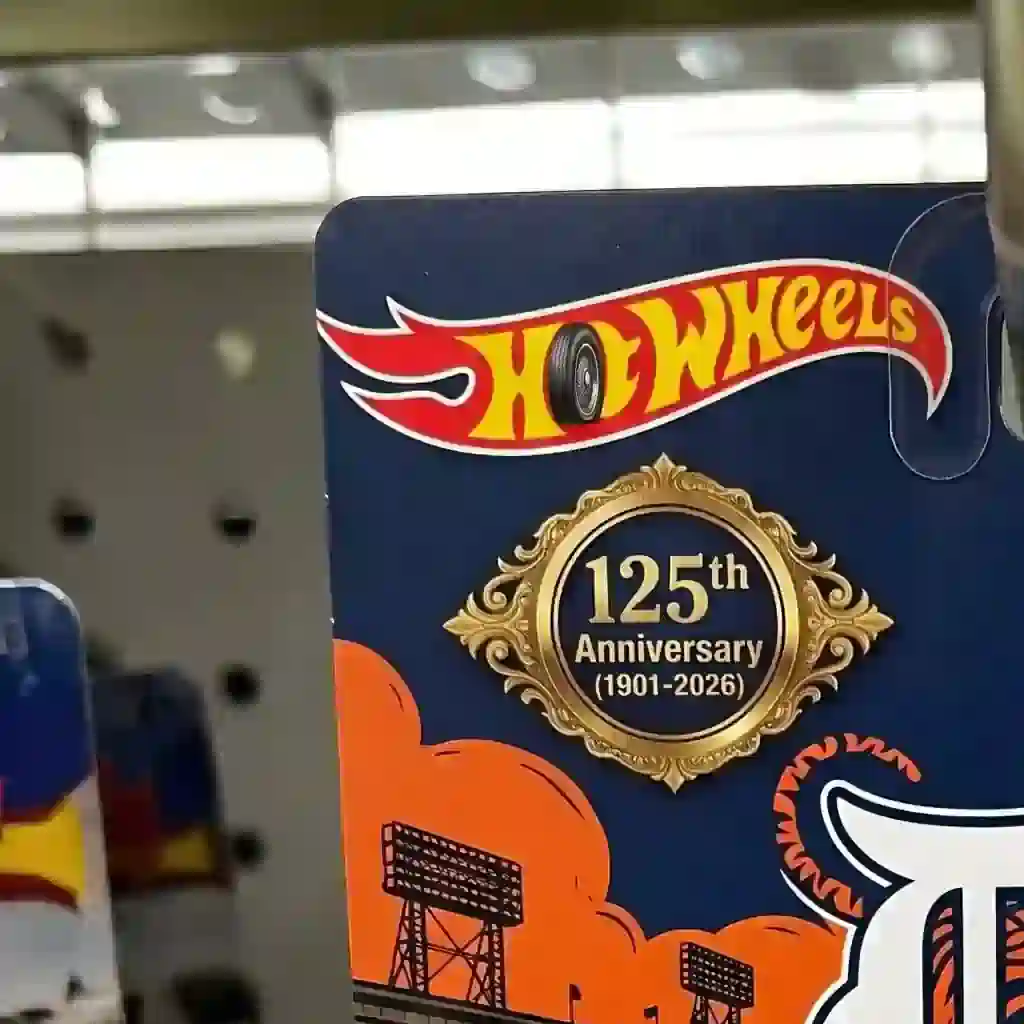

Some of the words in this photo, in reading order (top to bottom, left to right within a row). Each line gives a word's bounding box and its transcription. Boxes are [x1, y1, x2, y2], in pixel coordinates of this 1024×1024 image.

[585, 552, 750, 625] 125th
[574, 632, 763, 669] Anniversary
[595, 672, 745, 700] (1901-2026)
